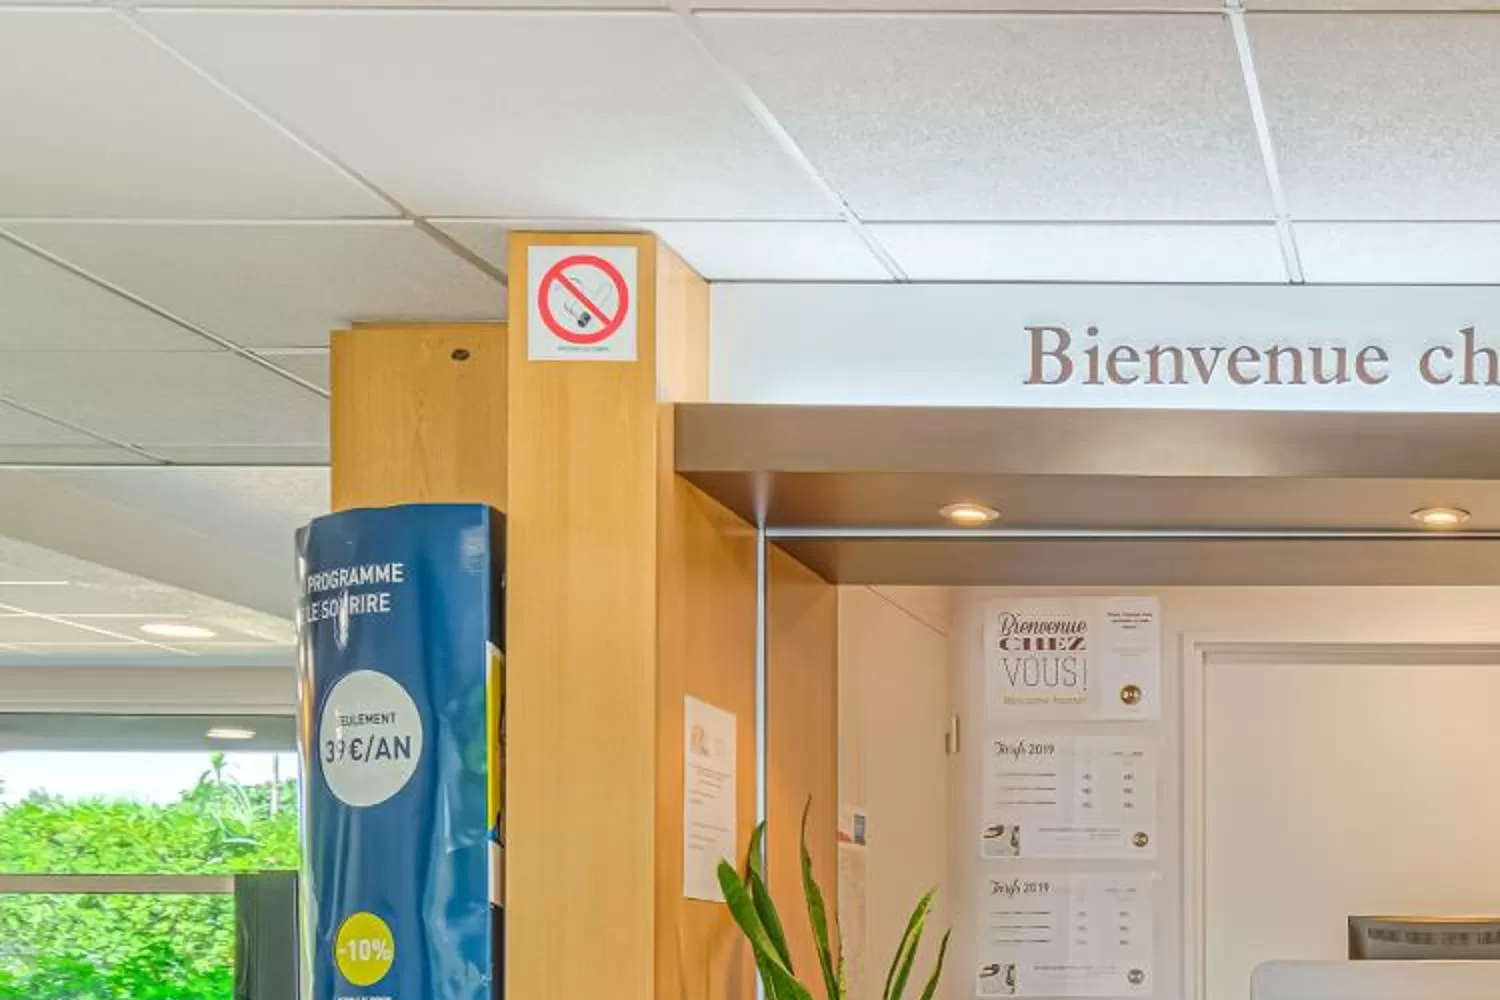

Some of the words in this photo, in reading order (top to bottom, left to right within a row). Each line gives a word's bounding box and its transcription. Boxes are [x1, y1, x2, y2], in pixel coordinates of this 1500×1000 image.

[1022, 325, 1390, 386] Bienvenue
[307, 562, 405, 593] PROGRAMME
[998, 611, 1088, 637] Bienvenue
[336, 711, 397, 727] EULEMENT
[339, 938, 393, 961] -10%
